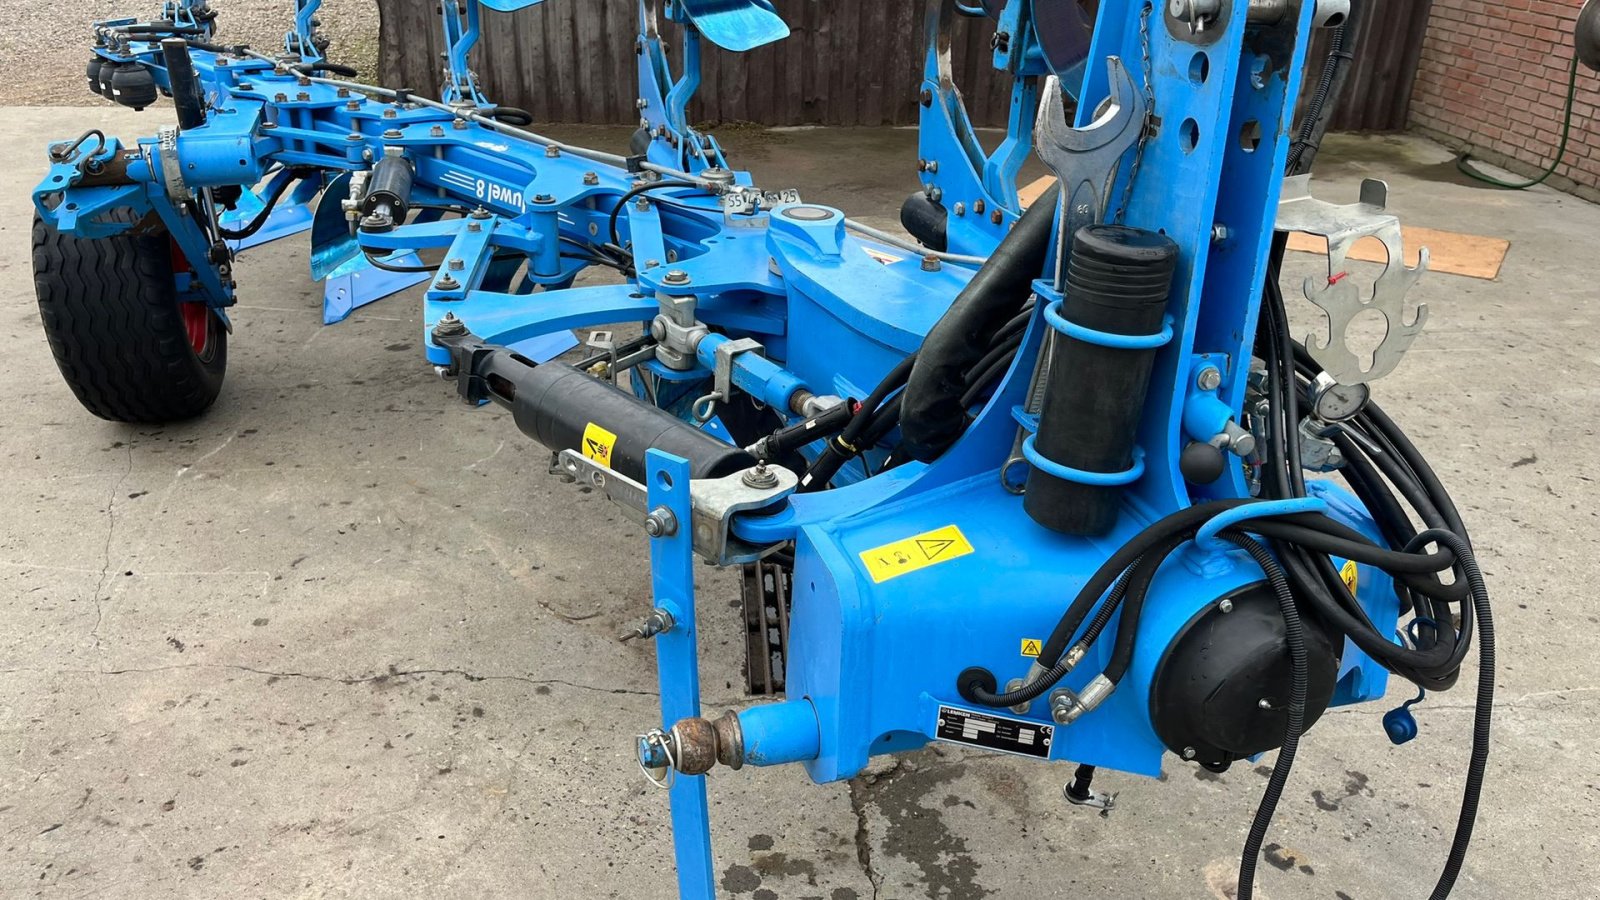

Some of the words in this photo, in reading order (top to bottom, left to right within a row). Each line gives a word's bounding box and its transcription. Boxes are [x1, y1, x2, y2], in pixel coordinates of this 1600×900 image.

[476, 179, 485, 198] 8
[728, 194, 742, 208] 55
[783, 190, 796, 203] 25
[947, 709, 971, 718] LEMKEN
